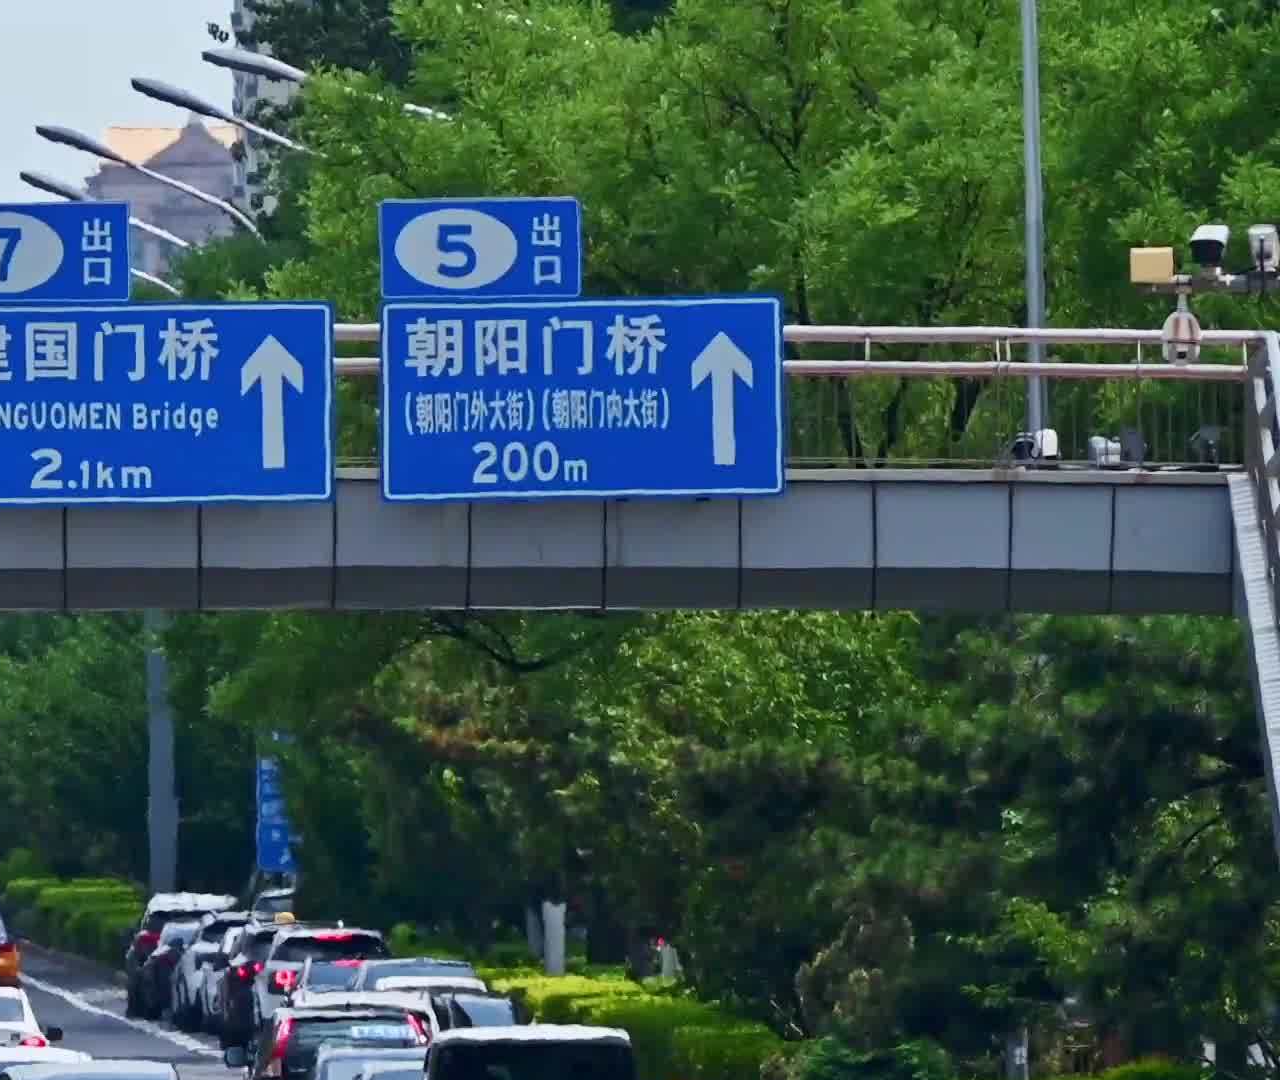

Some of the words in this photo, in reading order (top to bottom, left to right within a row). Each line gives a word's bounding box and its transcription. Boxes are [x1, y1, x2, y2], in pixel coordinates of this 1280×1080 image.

[81, 218, 113, 286] 出口
[436, 223, 478, 279] 5
[531, 212, 562, 285] 出口
[404, 314, 668, 377] 朝阳门桥
[132, 401, 219, 437] Bridge
[30, 447, 152, 490] 2.1km
[472, 440, 588, 484] 200m
